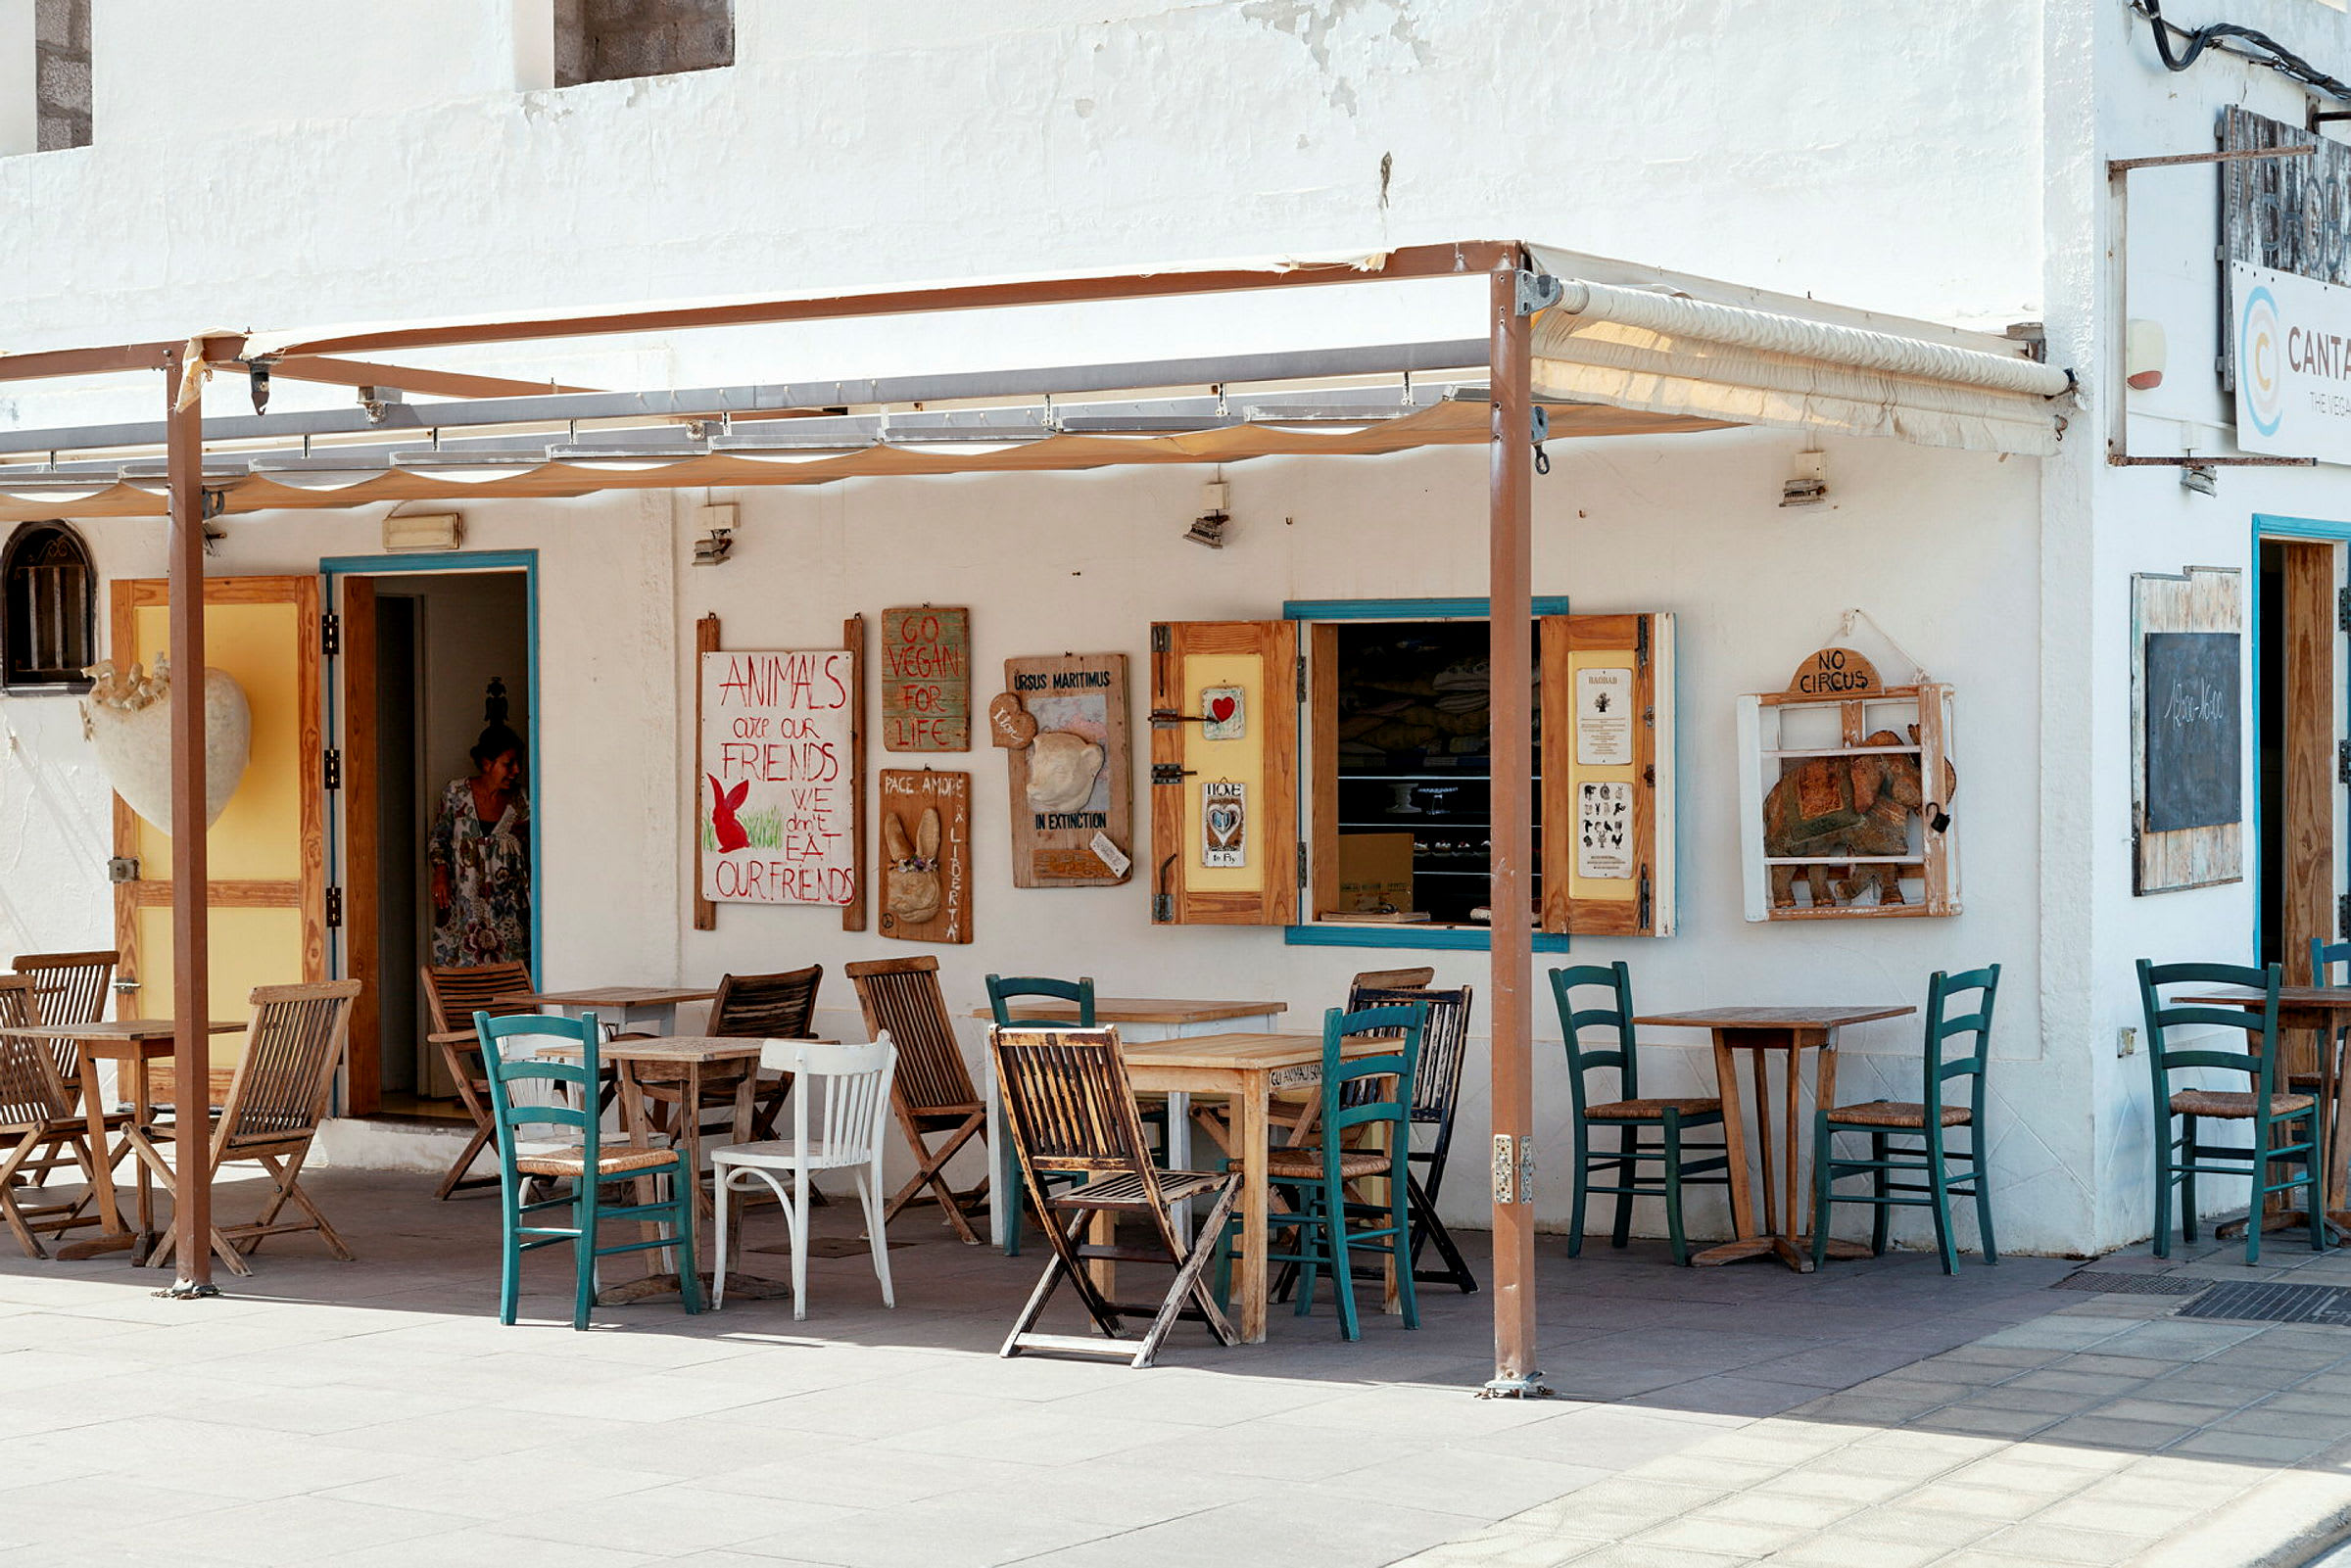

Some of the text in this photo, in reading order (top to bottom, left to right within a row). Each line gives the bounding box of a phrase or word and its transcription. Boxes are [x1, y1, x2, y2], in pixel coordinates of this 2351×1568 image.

[2310, 392, 2327, 414] THE
[901, 616, 939, 643] GO
[888, 642, 959, 678] VEGAN
[1818, 650, 1846, 671] NO
[719, 654, 846, 709] ANIMALS
[1014, 671, 1111, 690] URSUS MARITIMUS
[1799, 670, 1869, 694] CIRCUS
[902, 685, 948, 712] FOR
[895, 718, 950, 746] LIFE
[721, 742, 839, 782] FRIENDS
[792, 787, 833, 813] WE
[885, 777, 964, 798] PACE AMORE
[1035, 812, 1107, 831] IN EXTINCTION
[787, 832, 842, 862] EAT
[716, 860, 766, 900] OUR
